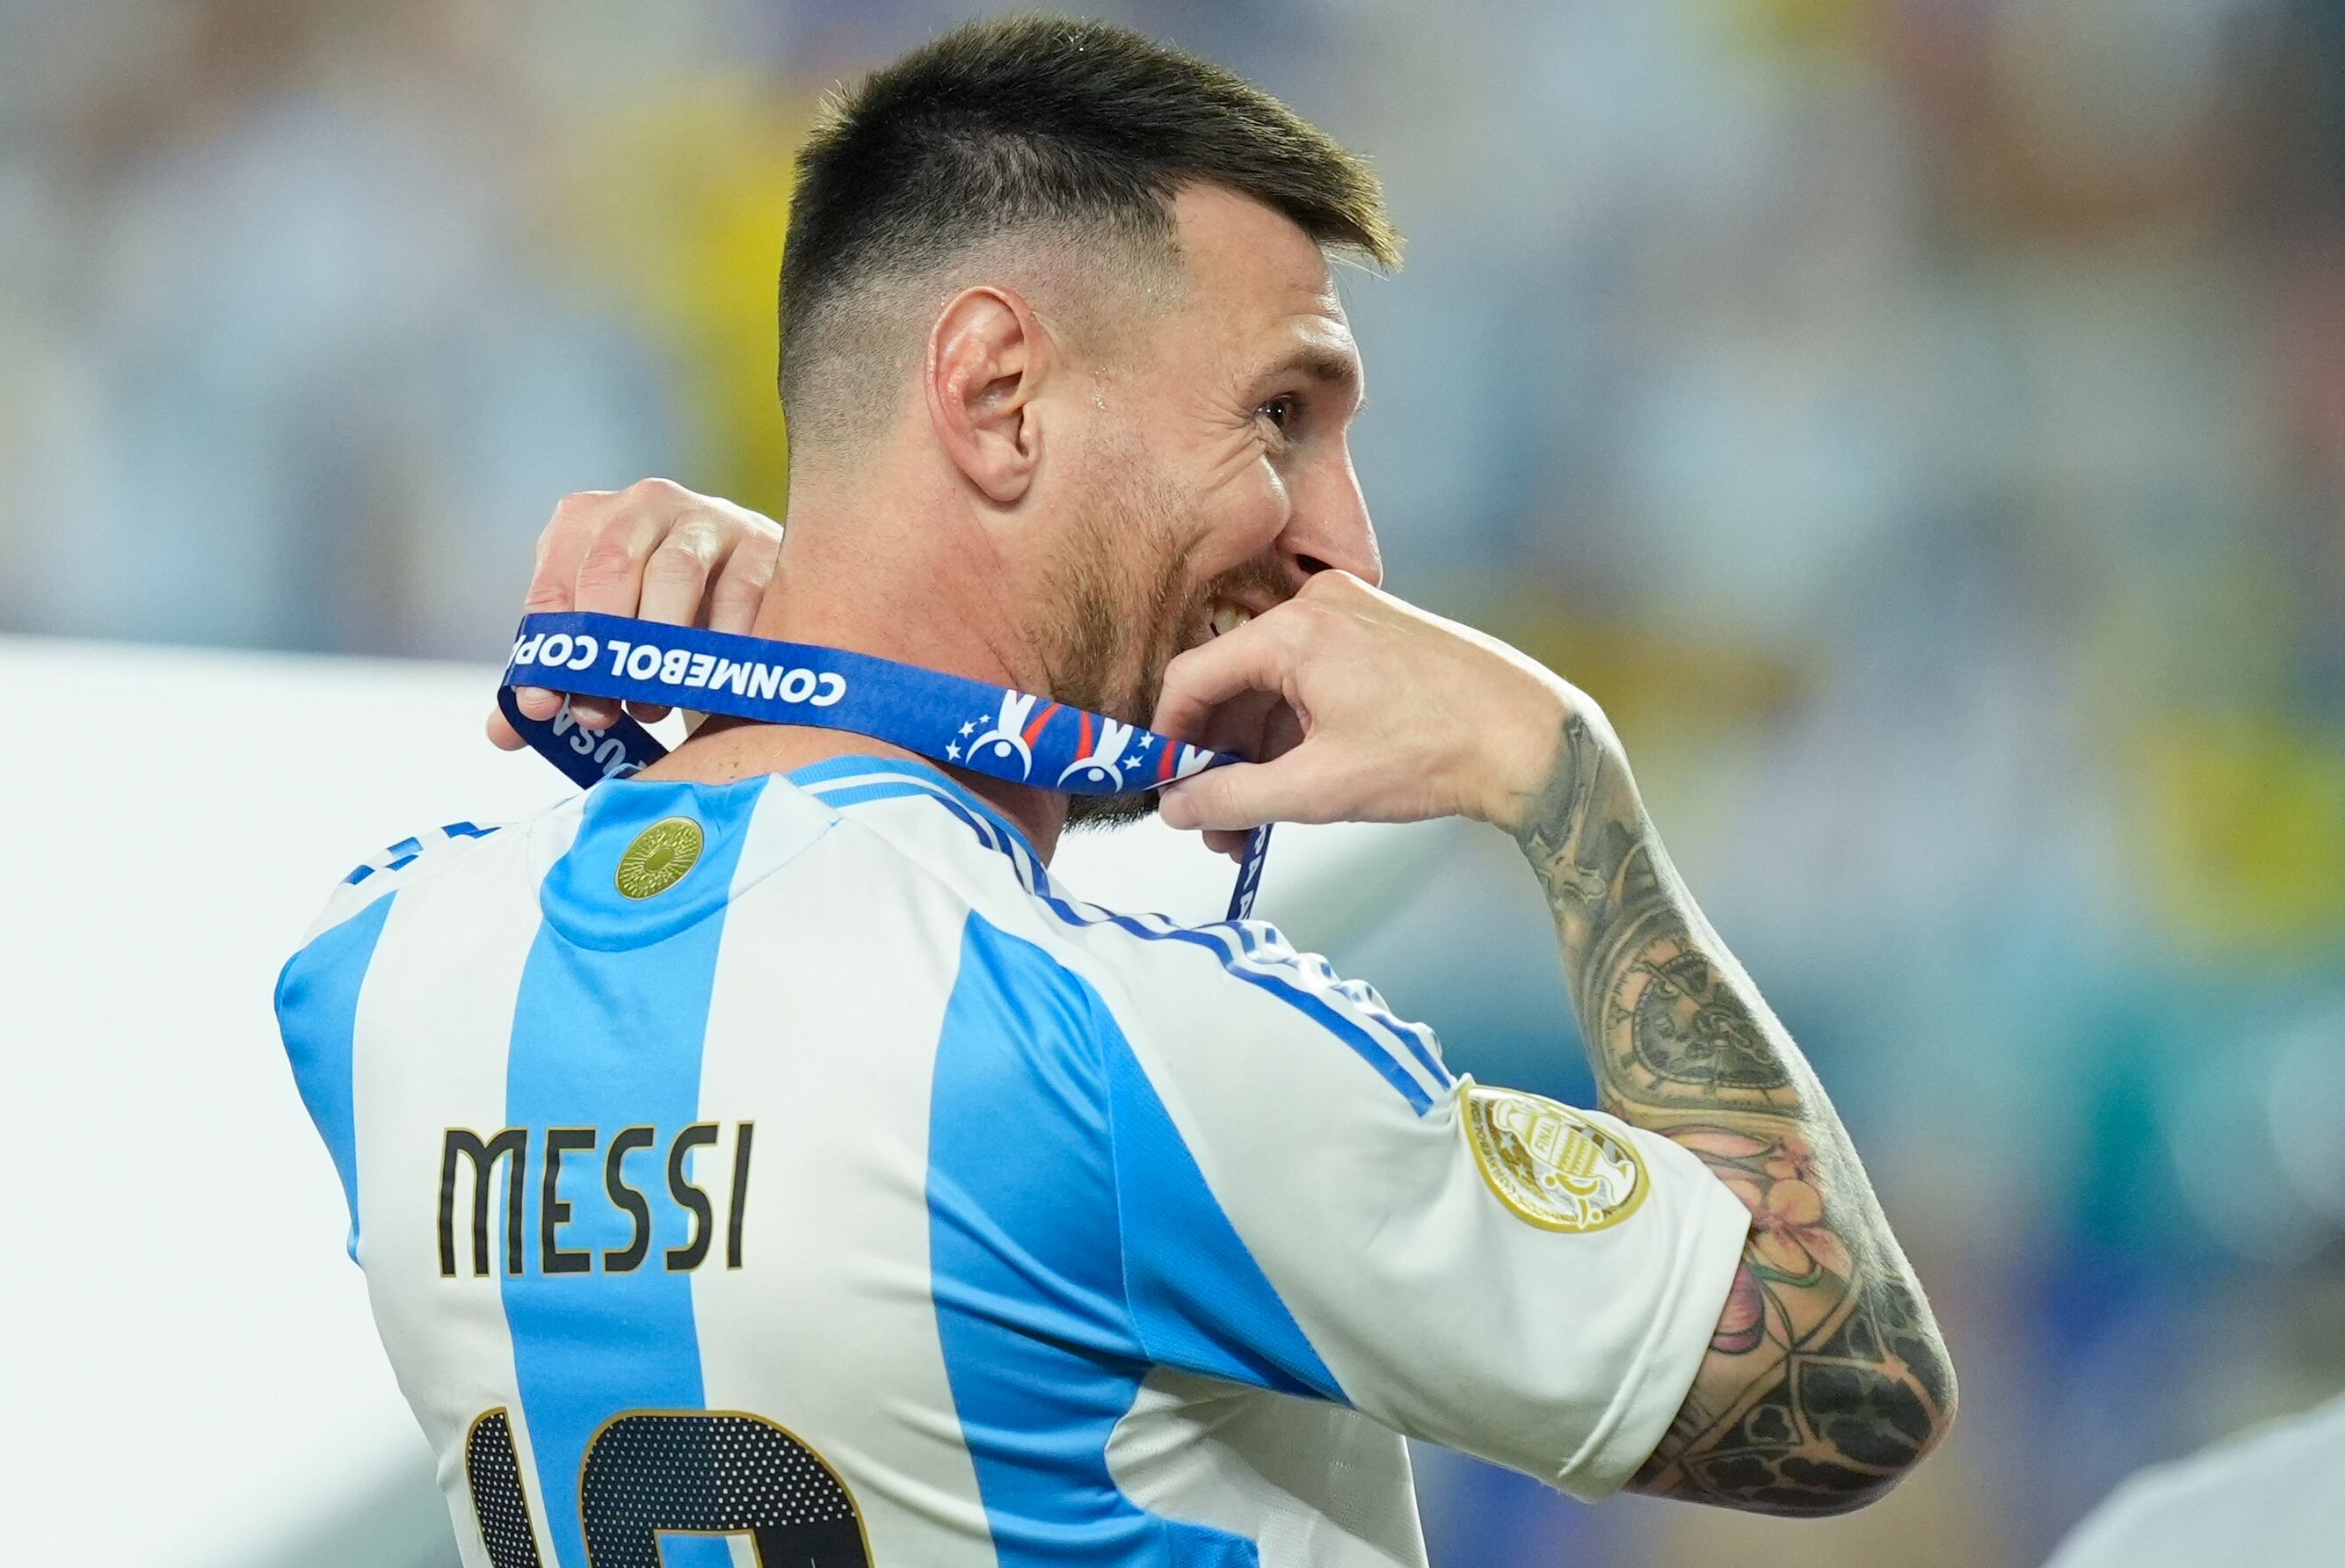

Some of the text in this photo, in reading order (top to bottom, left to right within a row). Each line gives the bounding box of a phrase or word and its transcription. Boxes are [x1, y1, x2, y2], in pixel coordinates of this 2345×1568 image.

[607, 639, 846, 707] CONMEBOL
[1537, 1124, 1557, 1153] FINAL
[437, 1122, 754, 1277] MESSI
